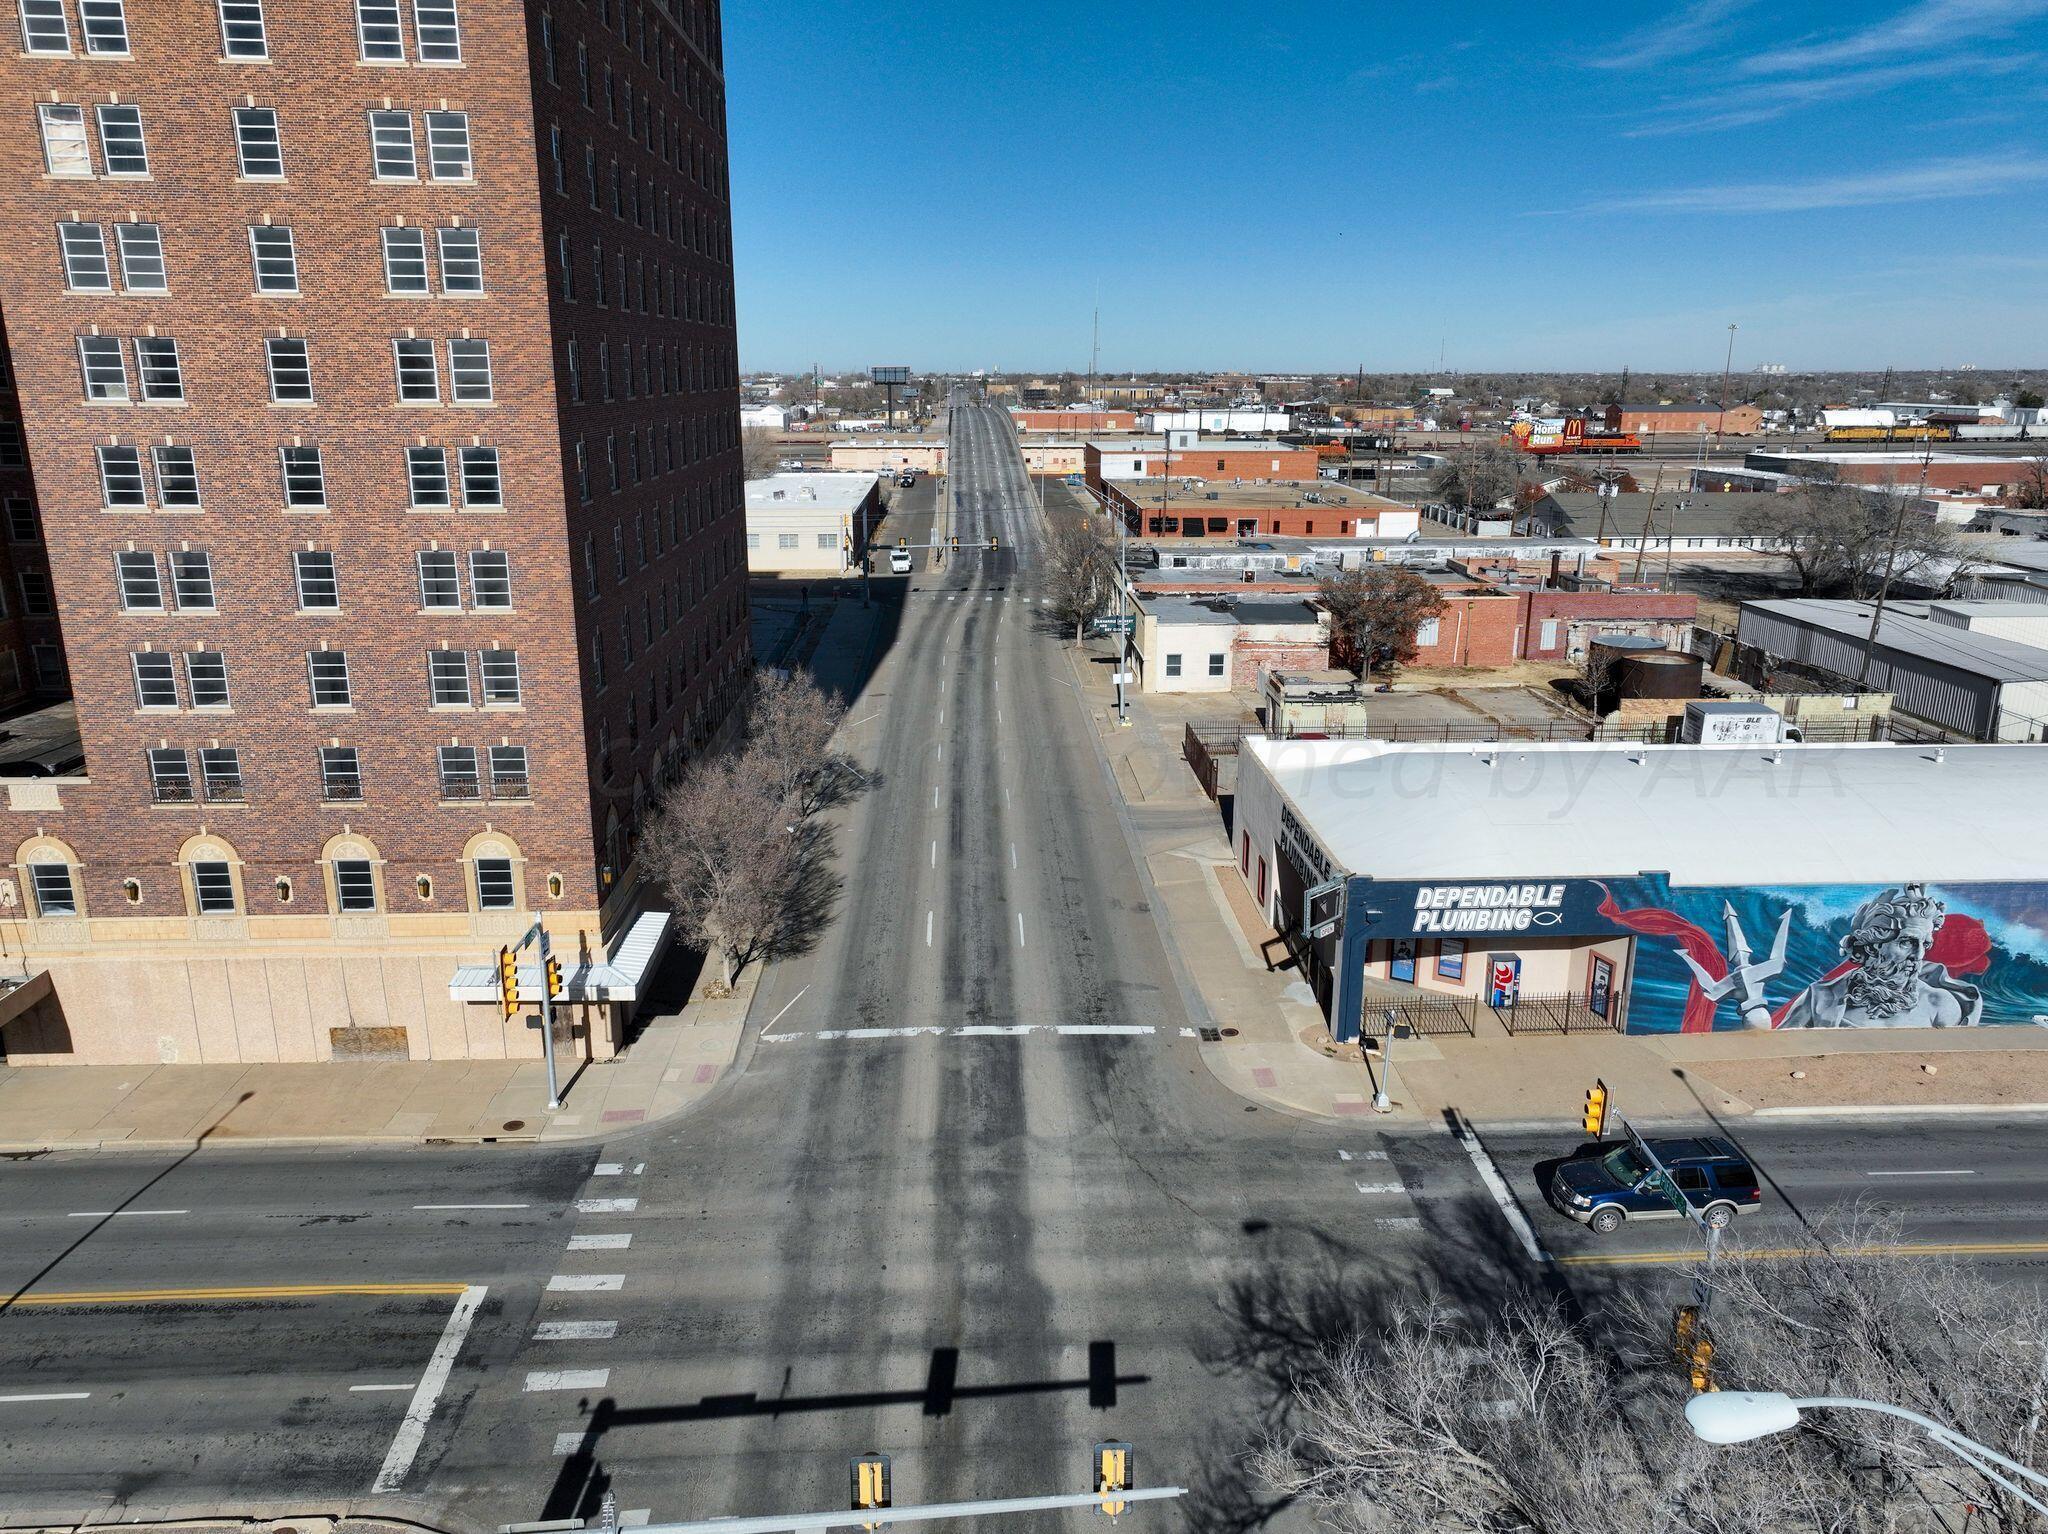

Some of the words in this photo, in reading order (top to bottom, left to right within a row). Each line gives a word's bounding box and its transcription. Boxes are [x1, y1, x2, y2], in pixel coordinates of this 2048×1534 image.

[1533, 424, 1562, 434] Home
[1533, 434, 1555, 444] Run.
[1281, 802, 1331, 882] DEPENDABLE
[1414, 885, 1566, 909] DEPENDABLE
[1412, 908, 1533, 932] PLUMBING
[1321, 926, 1334, 937] OPEN
